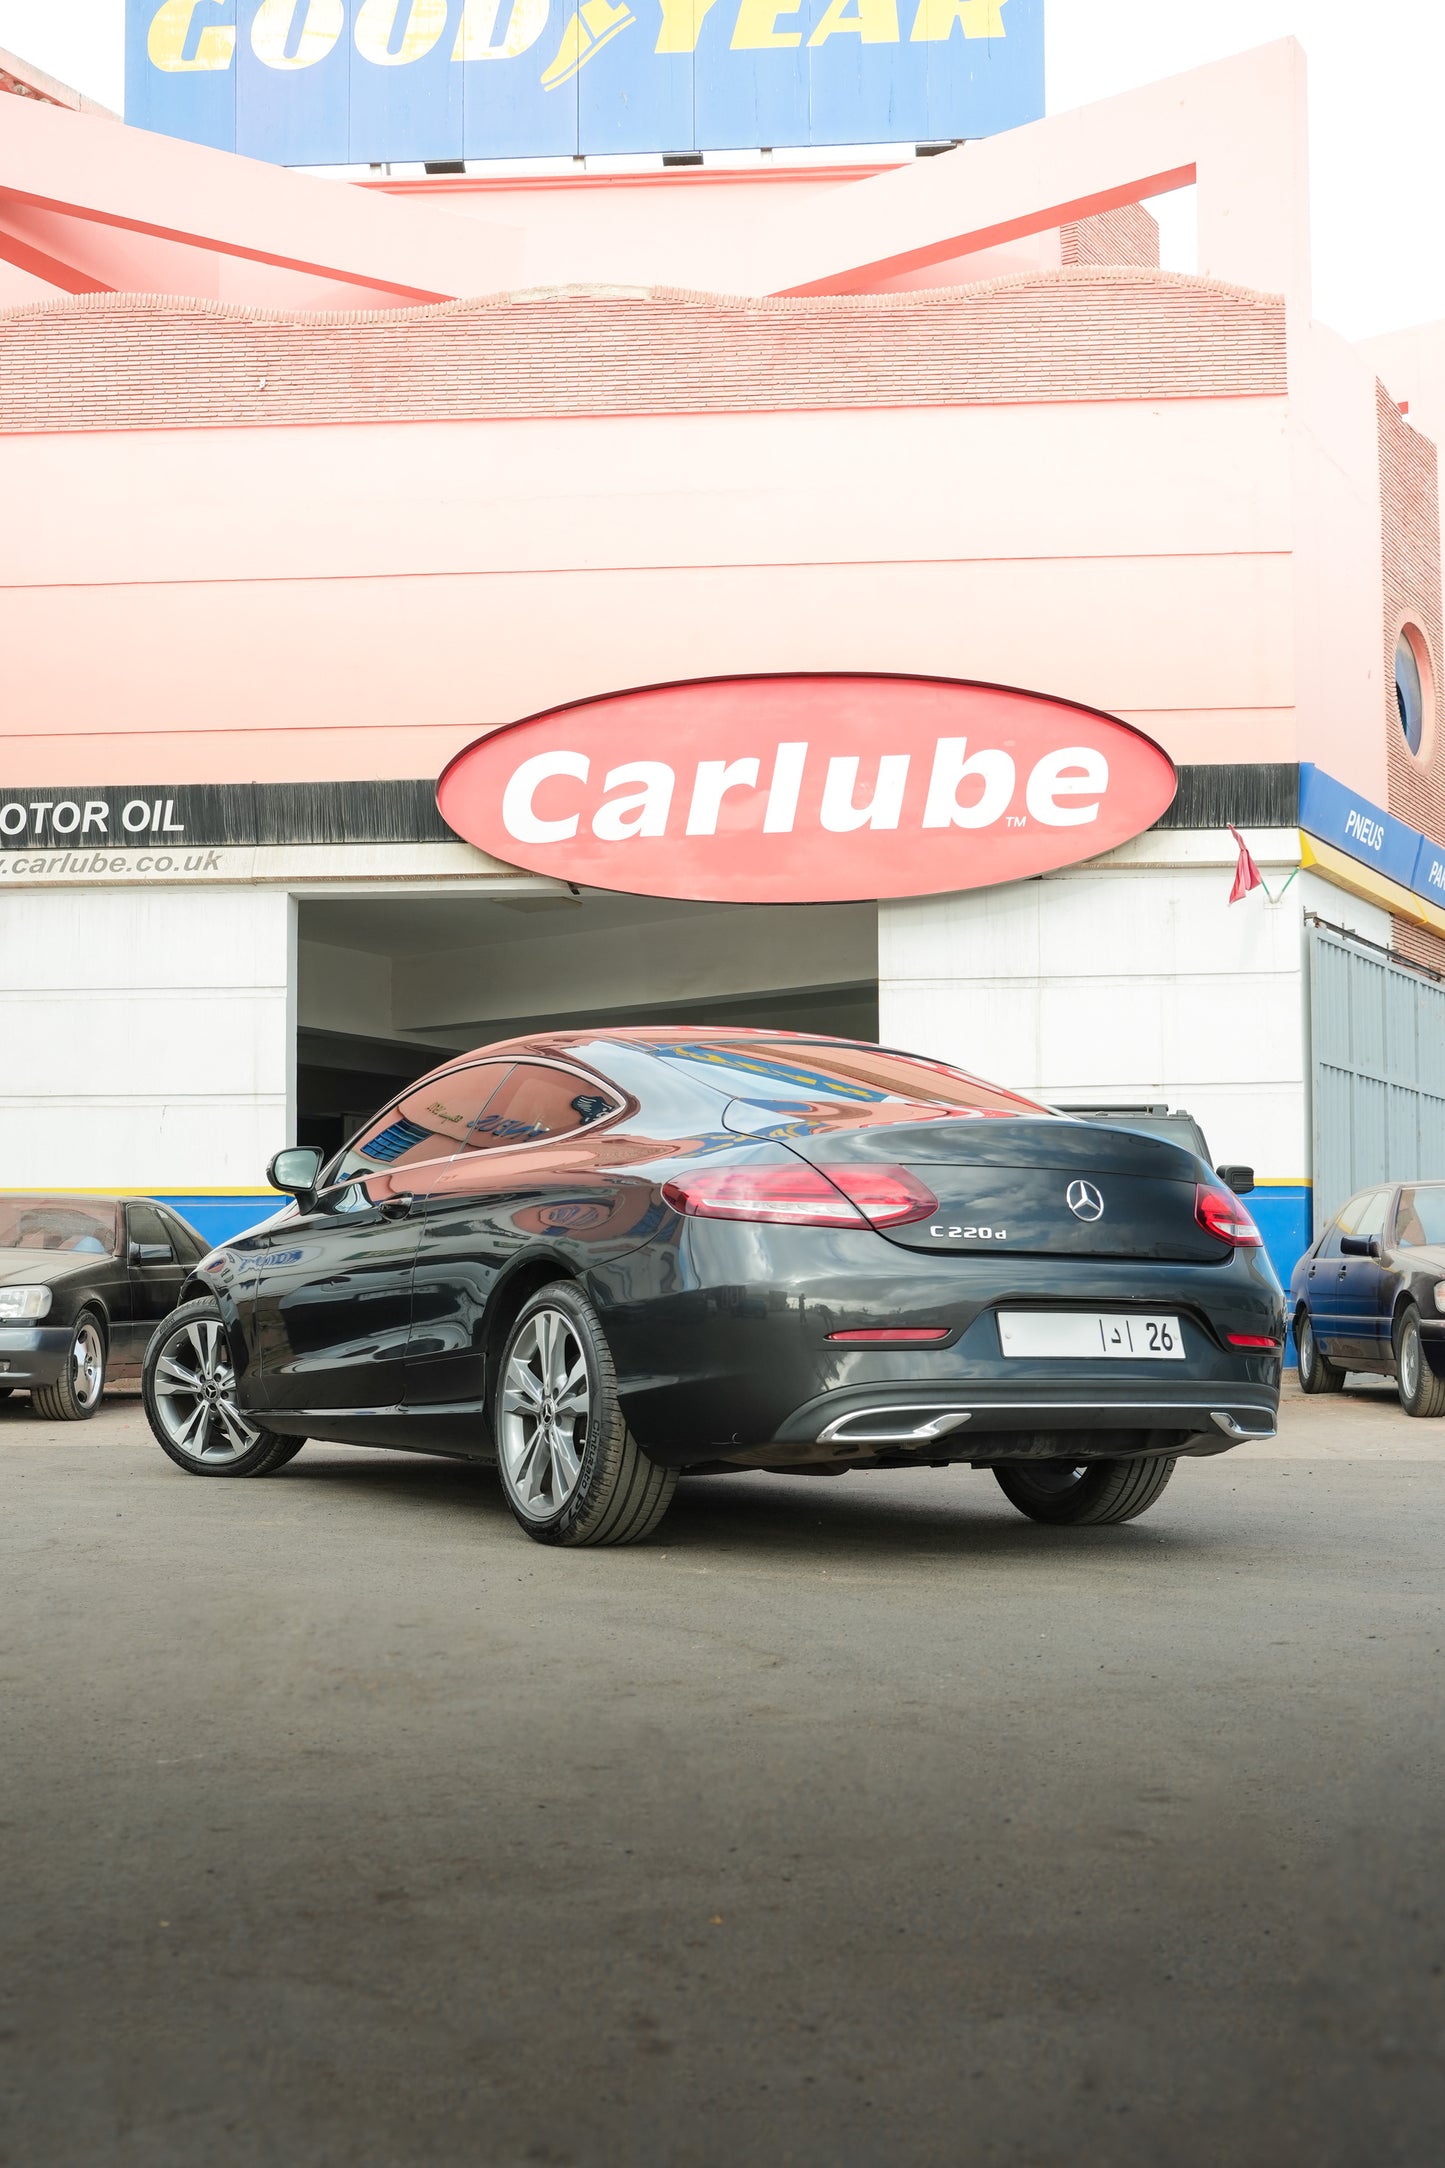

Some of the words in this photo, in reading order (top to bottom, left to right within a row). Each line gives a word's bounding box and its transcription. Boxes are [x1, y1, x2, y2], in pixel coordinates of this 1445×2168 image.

[502, 736, 1109, 844] Carlube
[0, 801, 109, 836] OTOR
[121, 799, 185, 833] OIL
[1345, 809, 1385, 851] PNEUS
[930, 1225, 944, 1238] C
[1146, 1322, 1173, 1351] 26
